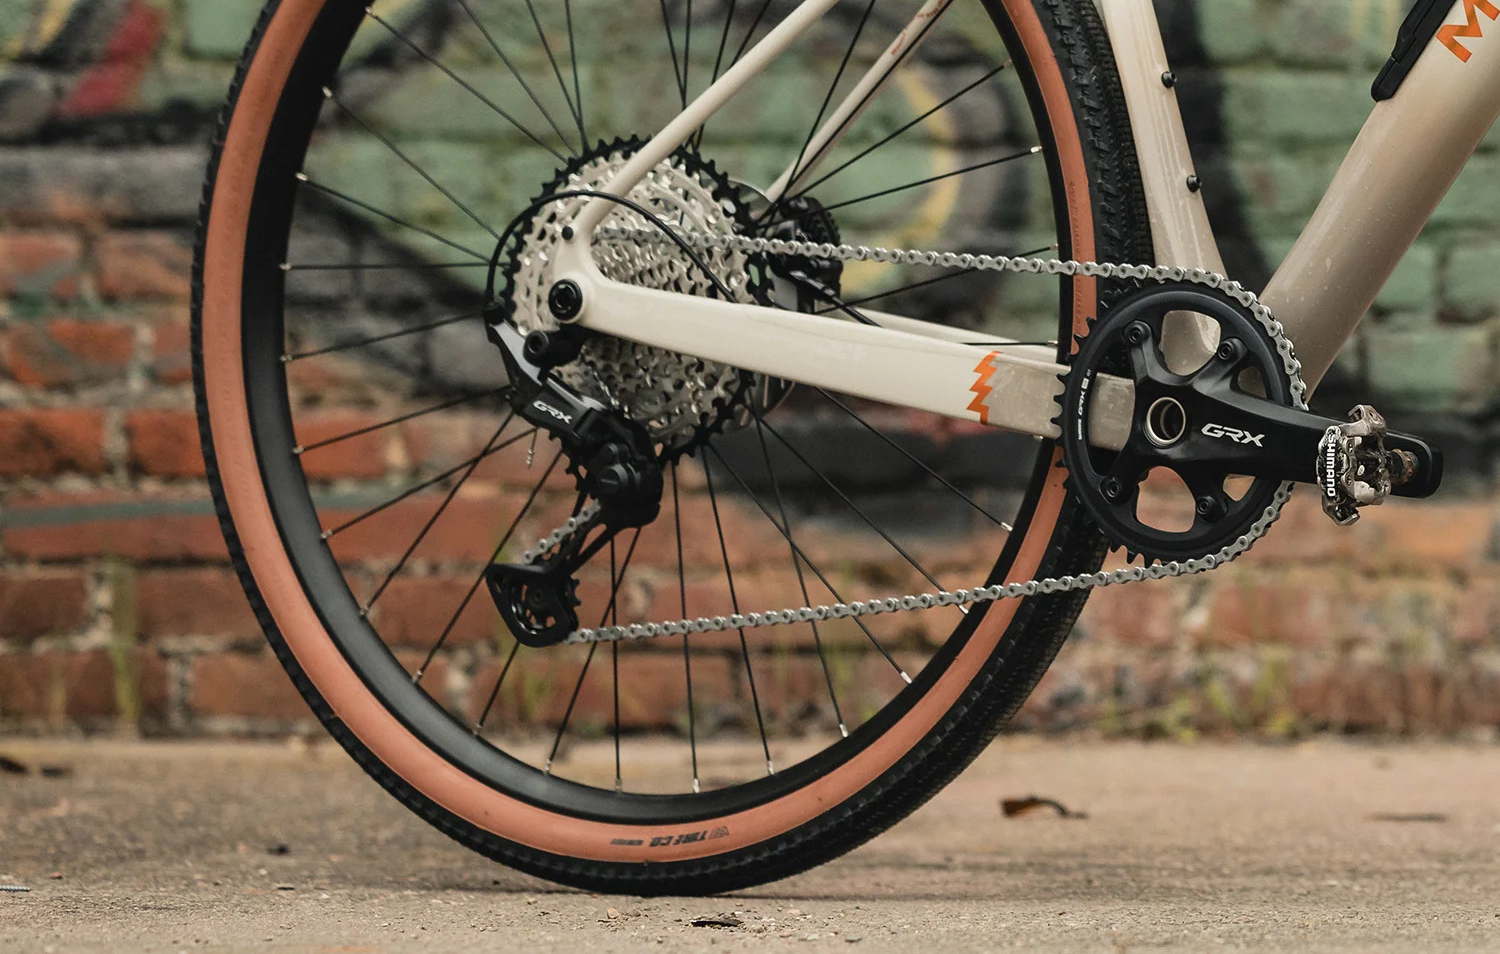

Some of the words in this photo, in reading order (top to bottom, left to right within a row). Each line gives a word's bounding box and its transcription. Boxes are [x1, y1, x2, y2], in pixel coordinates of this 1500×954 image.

[532, 400, 573, 425] GRX
[1200, 422, 1266, 448] GRX
[1326, 433, 1337, 498] SHIMANO
